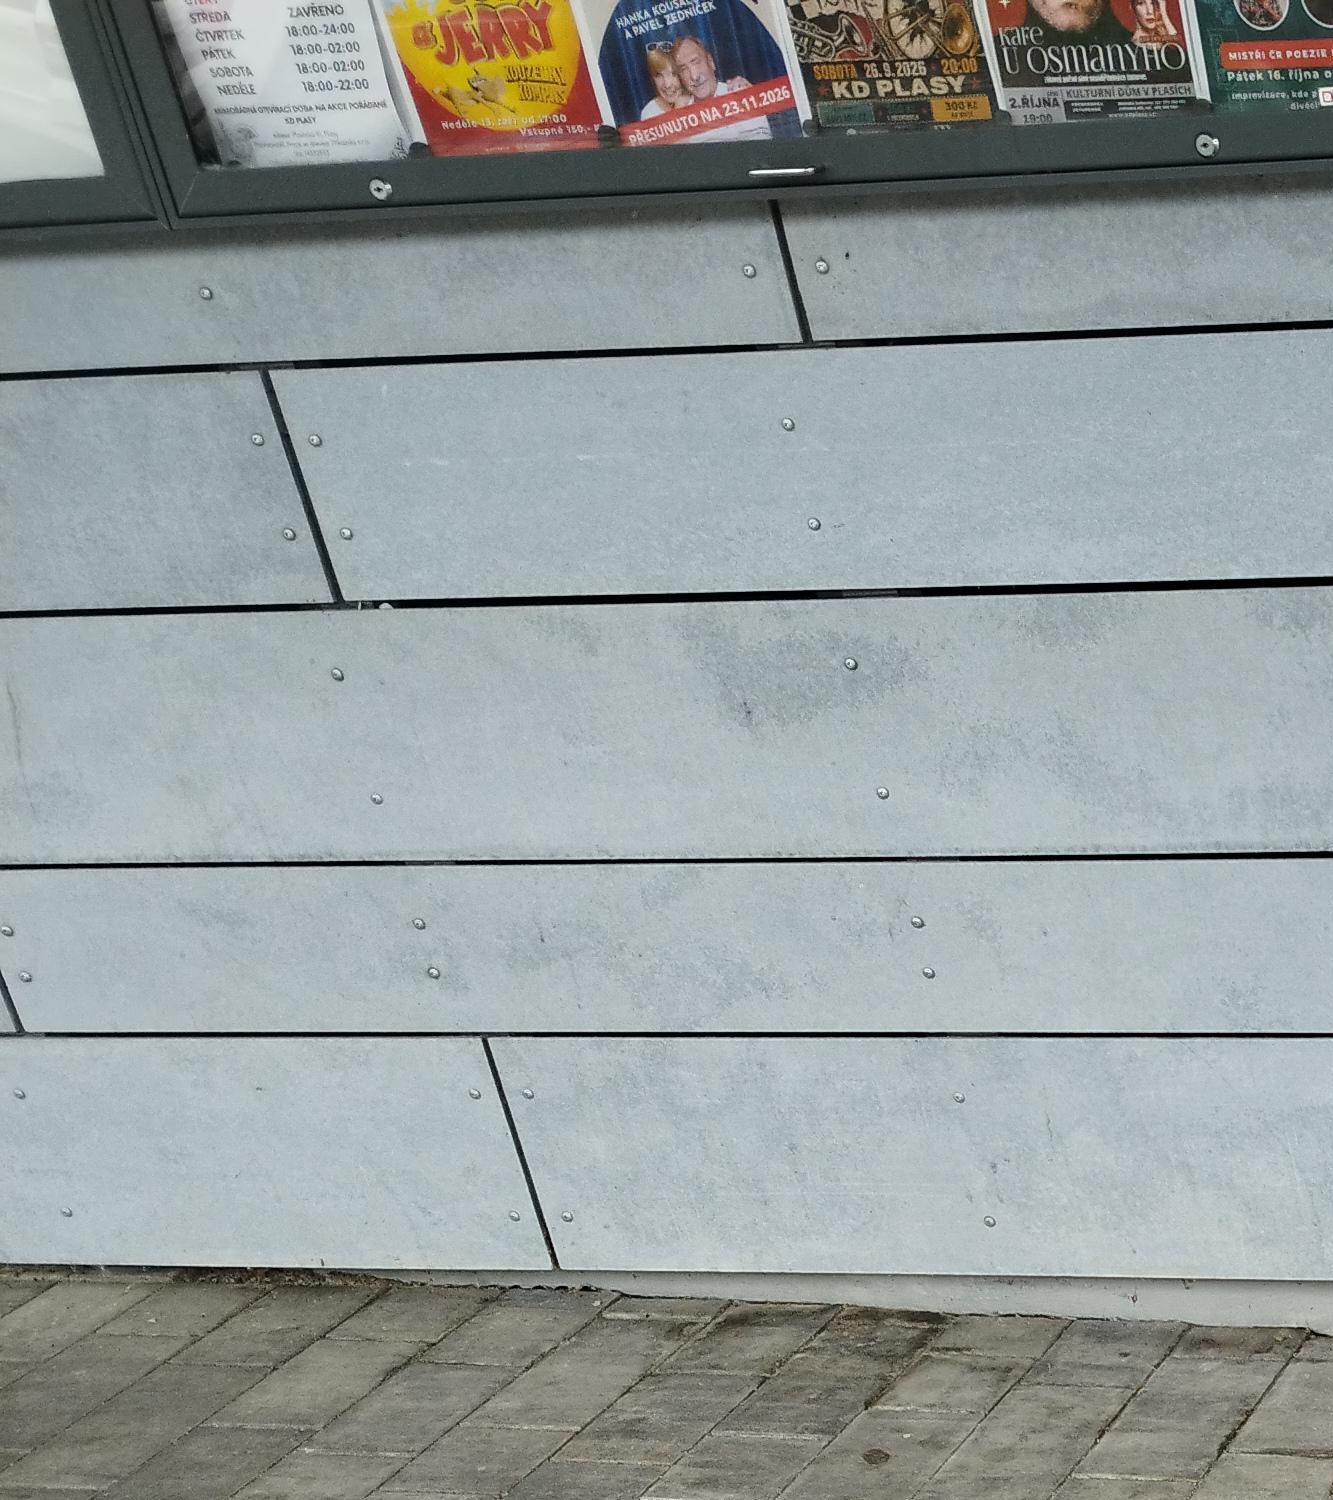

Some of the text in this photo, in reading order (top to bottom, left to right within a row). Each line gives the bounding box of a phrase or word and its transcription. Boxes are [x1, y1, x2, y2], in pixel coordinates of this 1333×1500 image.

[189, 3, 344, 24] STŘEDA ZAVŘENO
[615, 9, 651, 29] HANKA
[623, 1, 717, 40] A PAVEL ZEDNÍČEK
[195, 22, 355, 42] ČTVRTEK 18:00-24:00
[434, 1, 554, 66] JERRY
[201, 41, 360, 60] PÁTEK 18:00-02:00
[1002, 47, 1020, 74] U
[1228, 50, 1265, 61] MISTŘI
[1269, 49, 1283, 60] ČR
[1286, 48, 1328, 59] POEZIE
[209, 60, 365, 79] SOBOTA 18:00-02:00
[813, 57, 978, 80] SOBOTA 26.9.2026 20:00
[1227, 69, 1264, 82] Pátek
[1268, 69, 1286, 81] 16.
[1288, 69, 1320, 83] října
[217, 78, 369, 96] NEDĚLE 18:00-22:00
[831, 75, 966, 99] KD PLASY
[1066, 87, 1115, 98] KULTURNÍ
[1152, 86, 1191, 96] PLASÍCH
[628, 111, 699, 146] PŘESUNUTO
[700, 106, 722, 123] NA
[724, 86, 791, 117] 23.11.2026
